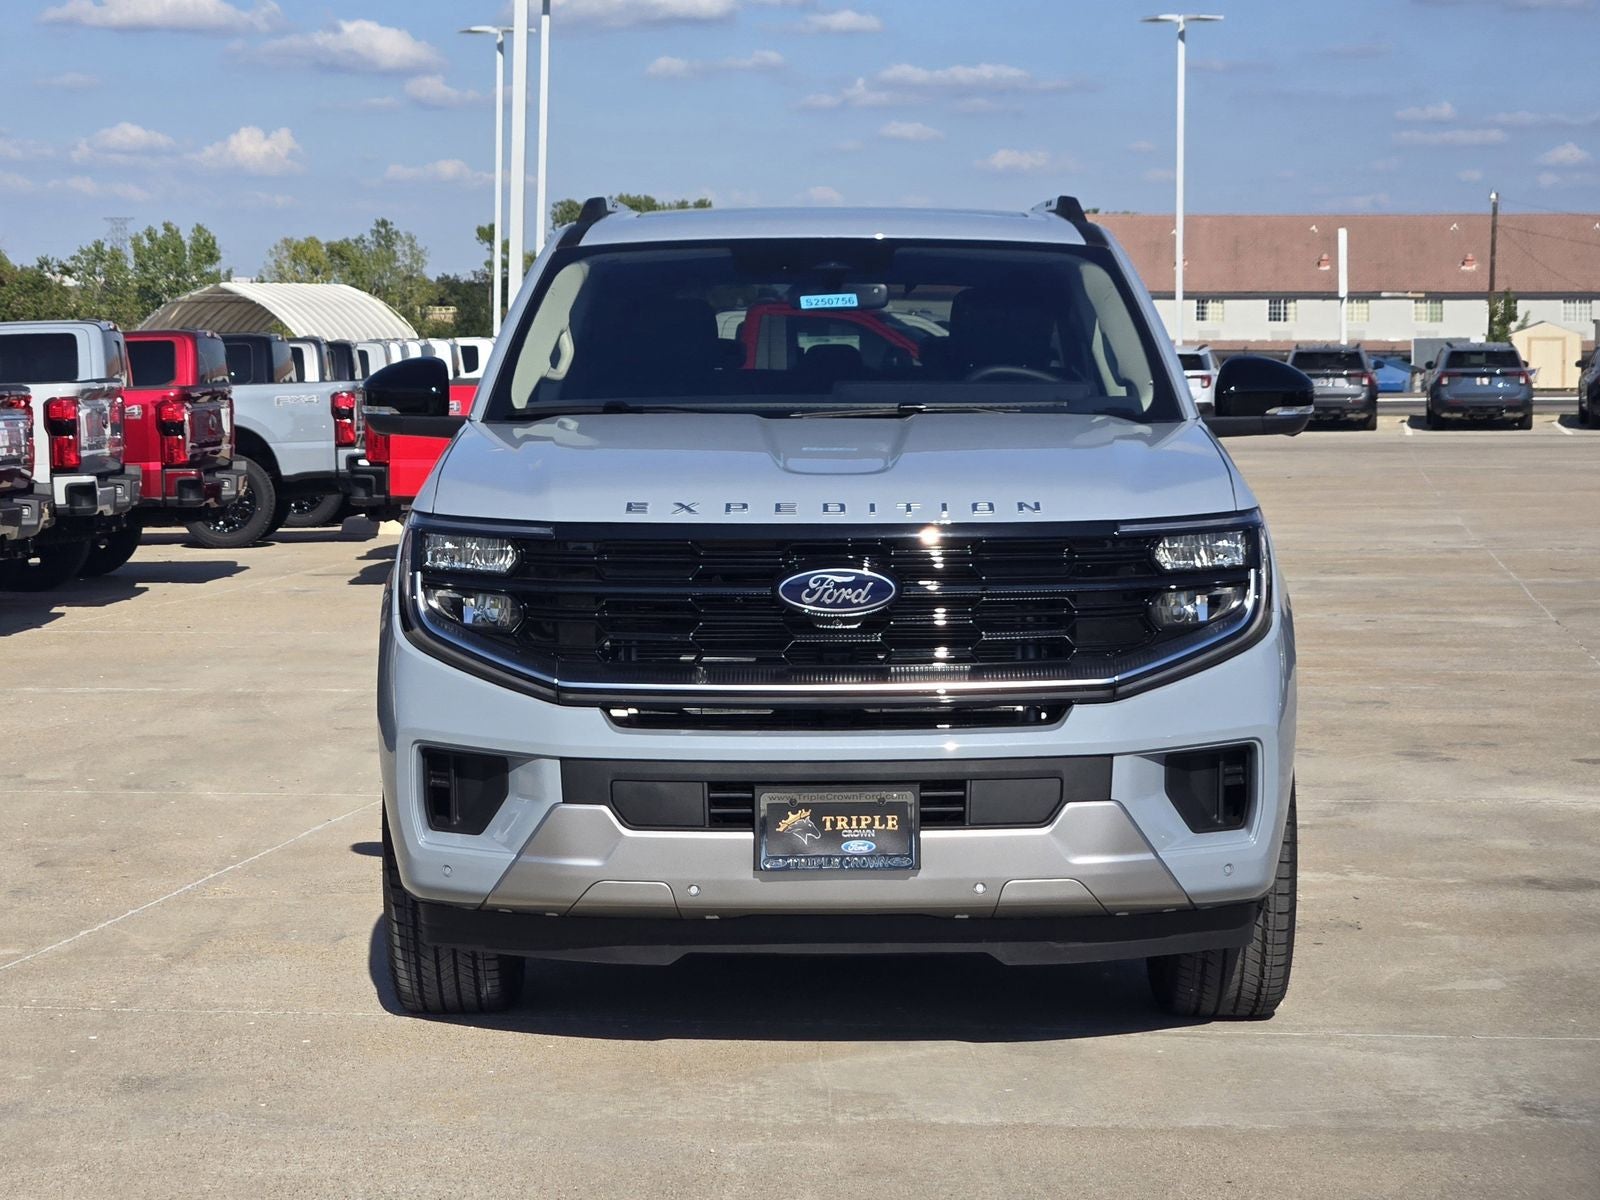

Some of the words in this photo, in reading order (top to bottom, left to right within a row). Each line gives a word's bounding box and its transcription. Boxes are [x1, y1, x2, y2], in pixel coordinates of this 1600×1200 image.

[805, 296, 855, 306] S250756
[625, 501, 1042, 517] EXPEDITION
[801, 574, 874, 604] Ford
[822, 815, 899, 831] TRIPLE
[841, 830, 876, 838] CROWN
[787, 857, 841, 868] TRIPLE
[842, 857, 890, 868] CROWN
